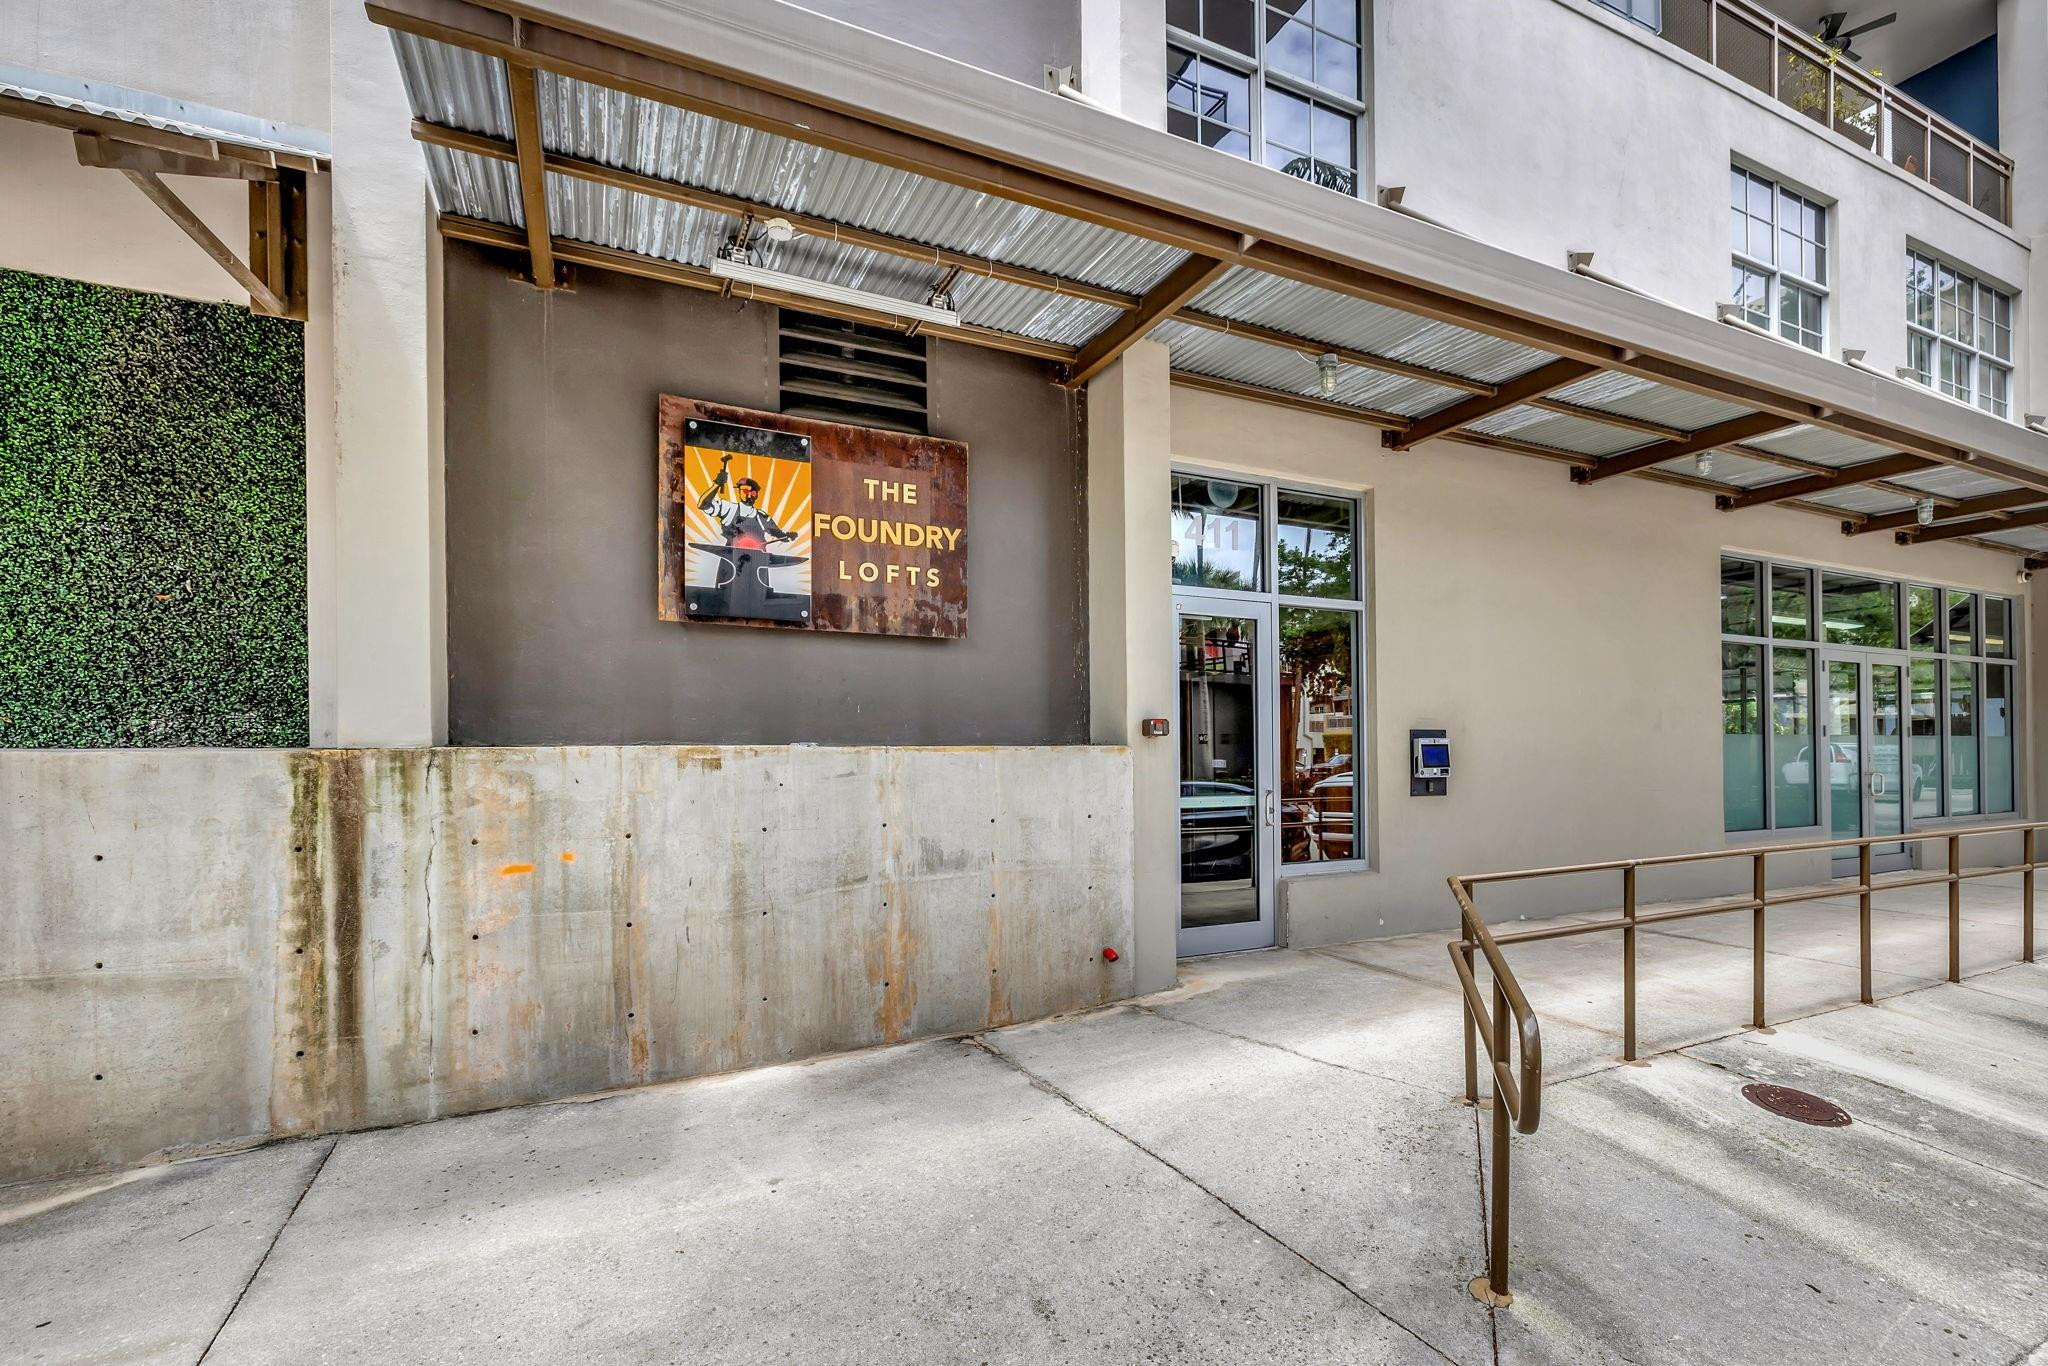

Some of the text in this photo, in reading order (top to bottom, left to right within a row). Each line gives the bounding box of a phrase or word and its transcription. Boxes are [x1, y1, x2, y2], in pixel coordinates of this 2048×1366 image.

[863, 478, 918, 505] THE
[813, 512, 962, 551] FOUNDRY
[1184, 515, 1240, 551] 411
[838, 560, 941, 588] LOFTS
